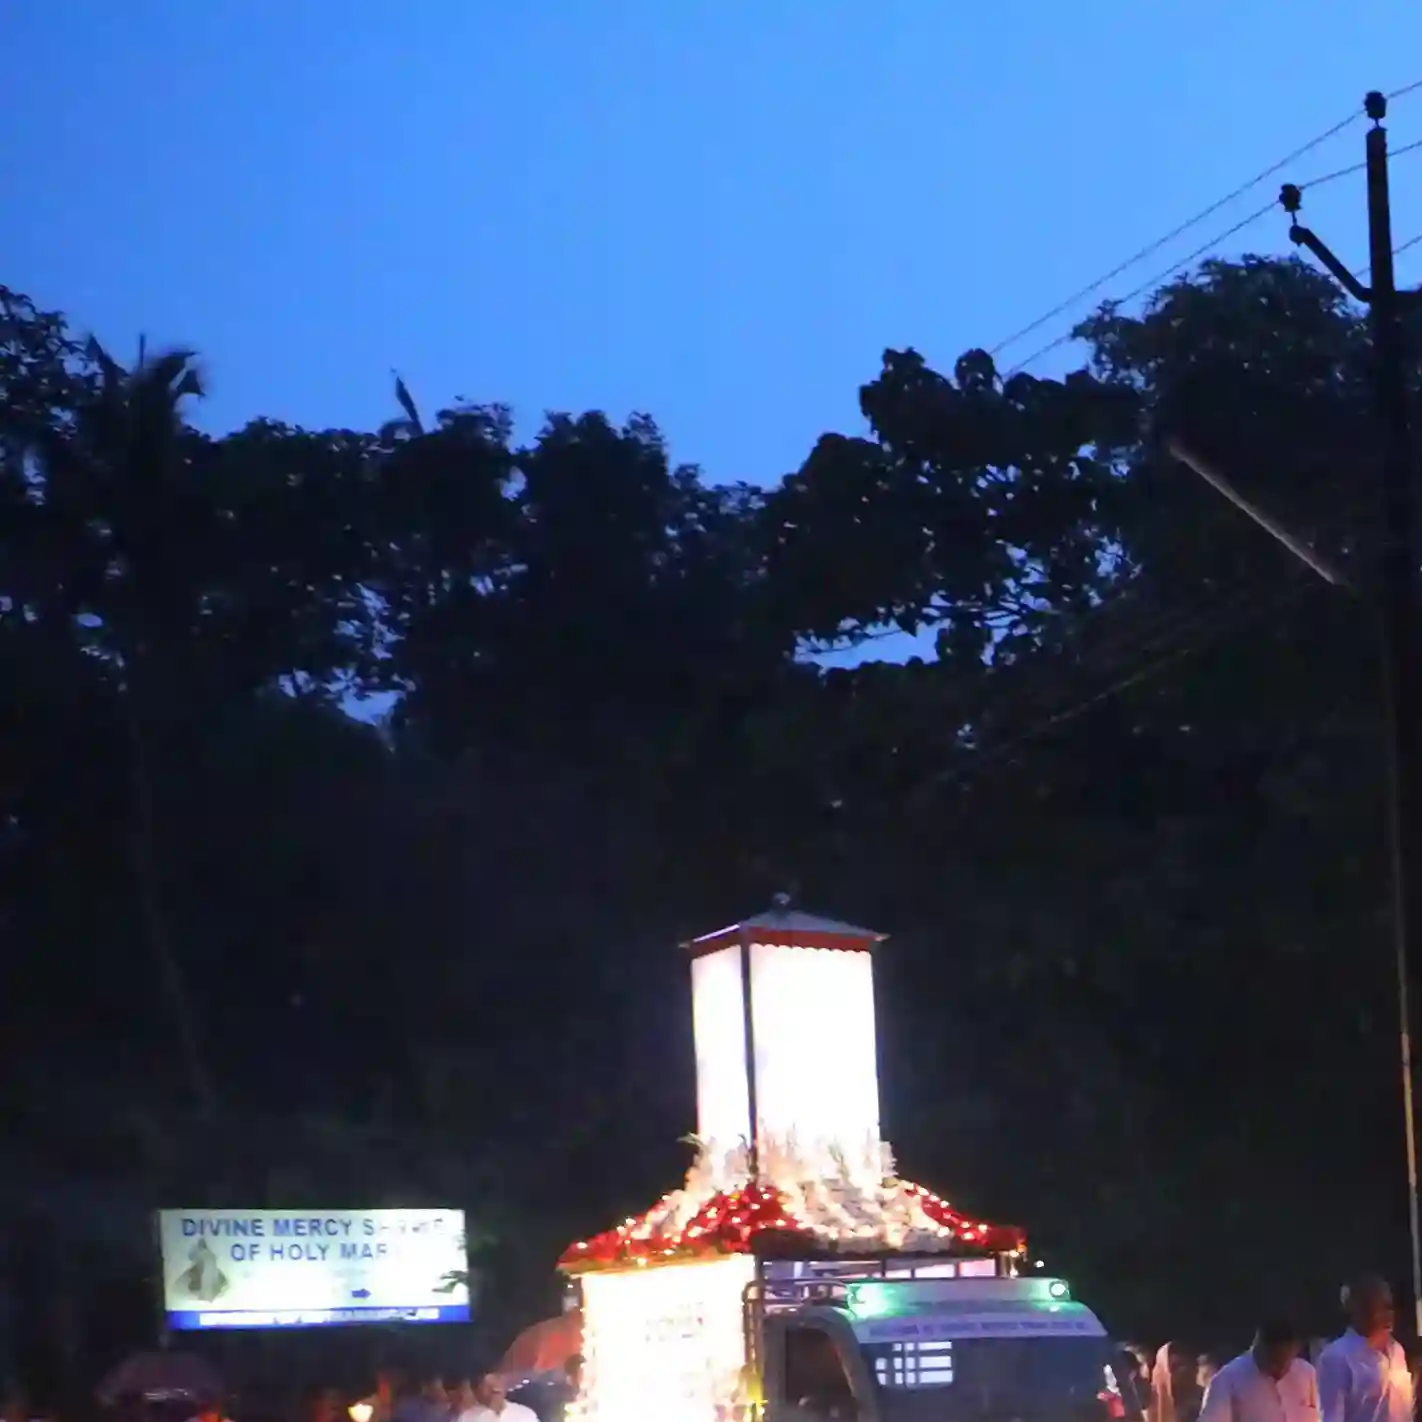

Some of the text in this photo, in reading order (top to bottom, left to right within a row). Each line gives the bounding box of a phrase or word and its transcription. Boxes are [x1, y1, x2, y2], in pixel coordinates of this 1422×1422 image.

[182, 1217, 265, 1237] DIVINE
[273, 1217, 352, 1238] MERCY
[231, 1243, 263, 1262] OF
[270, 1242, 330, 1262] HOLY
